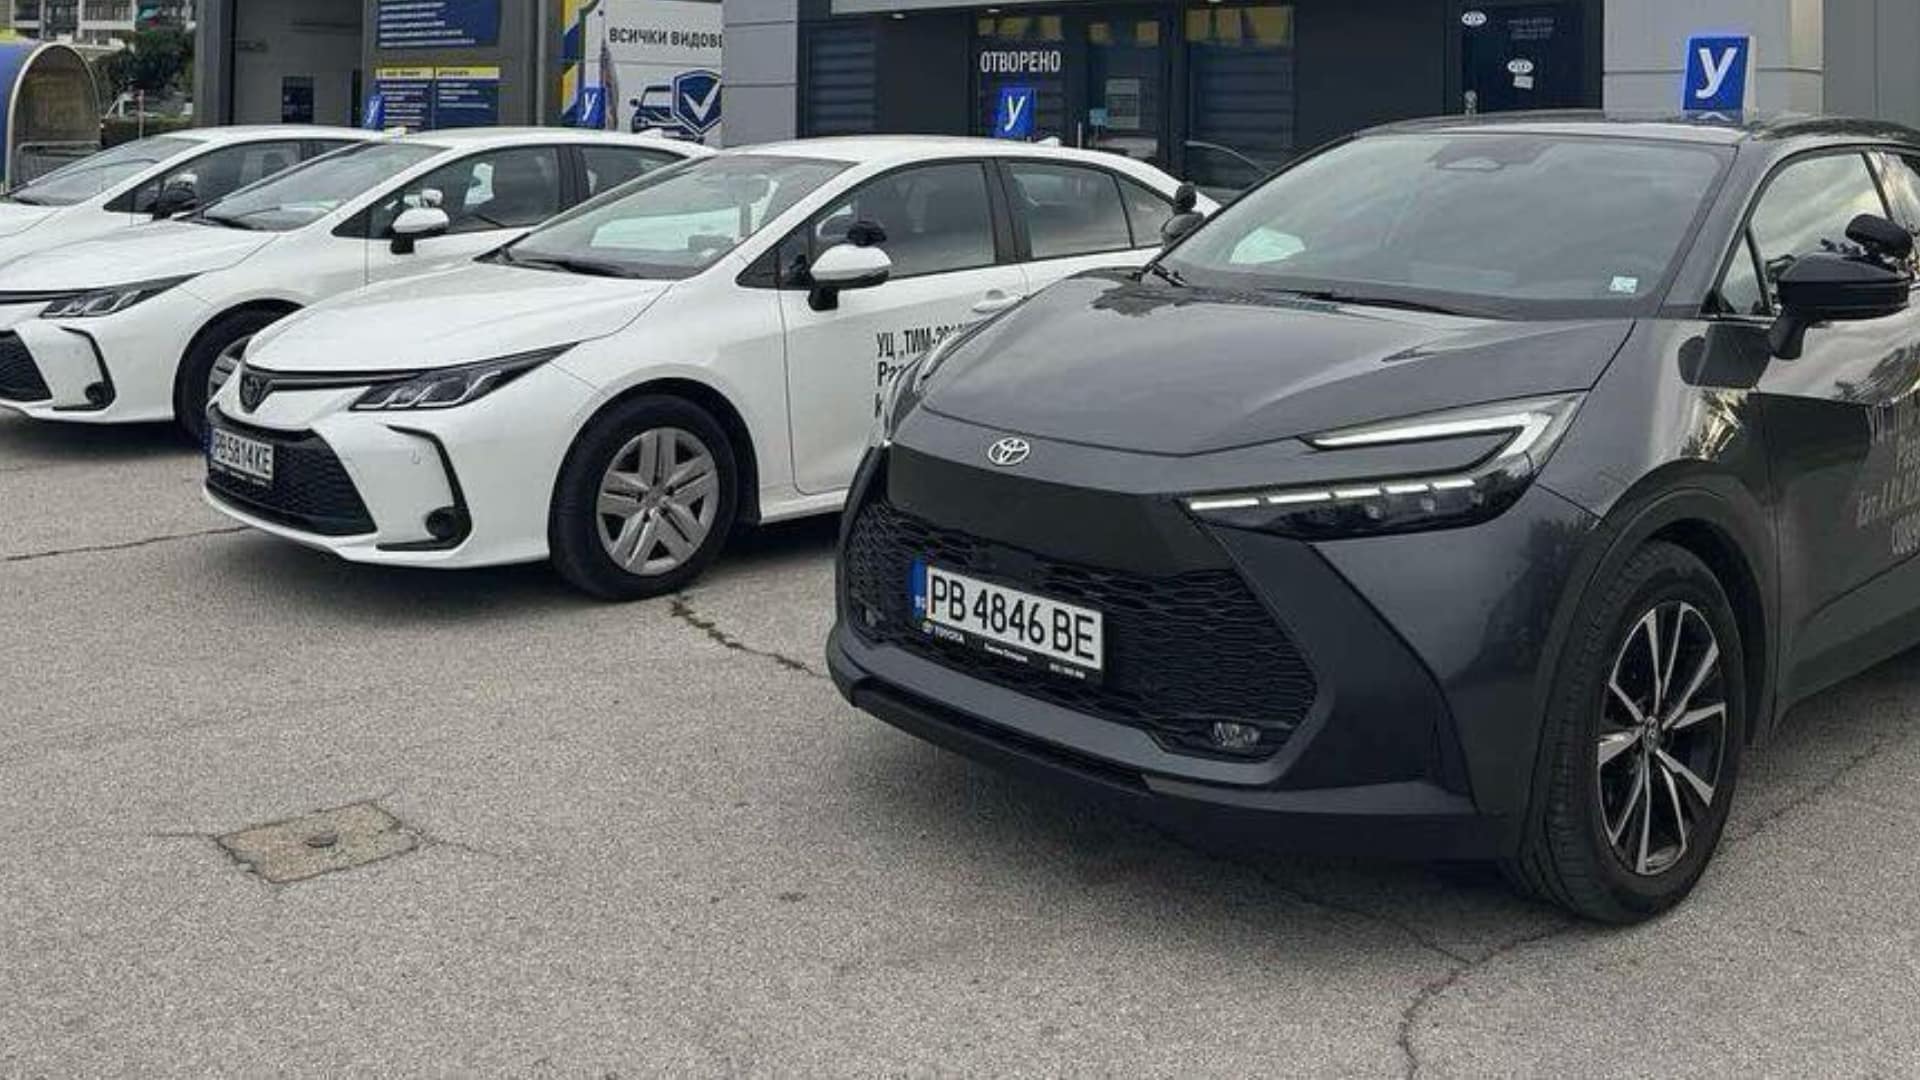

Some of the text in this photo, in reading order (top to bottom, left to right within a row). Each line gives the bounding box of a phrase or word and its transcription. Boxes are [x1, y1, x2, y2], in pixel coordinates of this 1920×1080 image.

[609, 27, 667, 44] ВСИЧКИ
[980, 51, 1062, 73] ОТВОРЕНО
[877, 332, 896, 360] УЦ
[931, 575, 967, 622] PB
[973, 588, 1046, 645] 4846
[1052, 607, 1096, 661] BE
